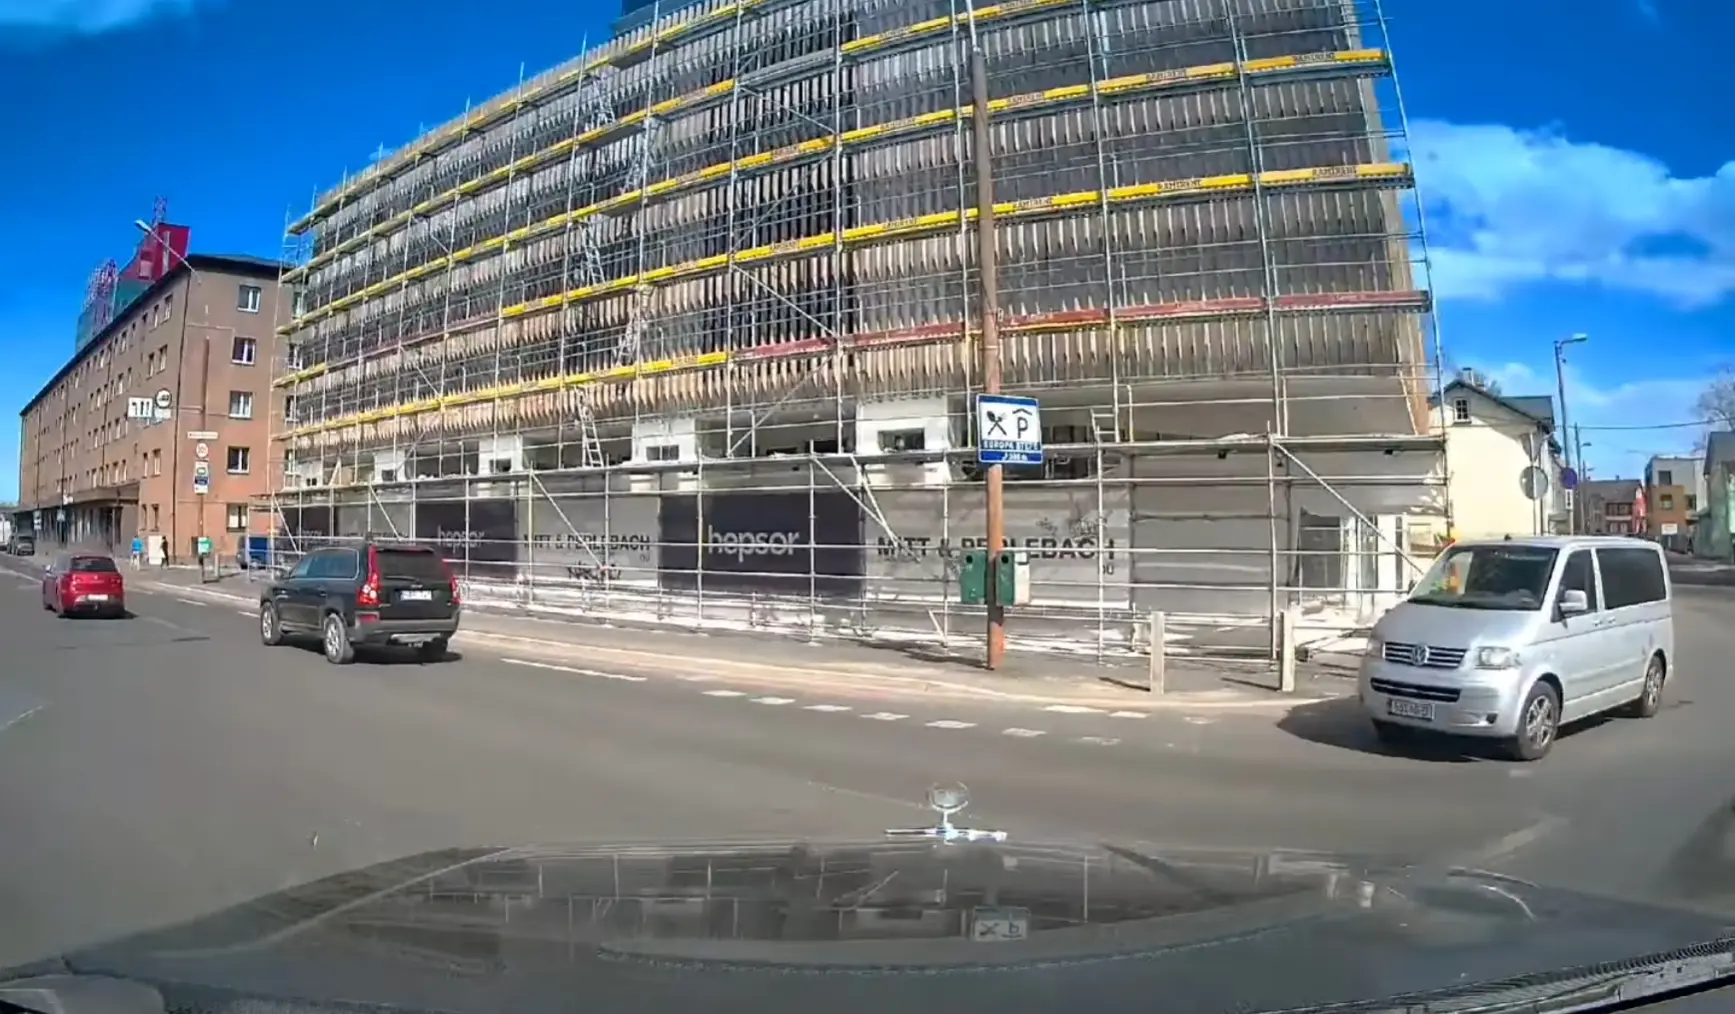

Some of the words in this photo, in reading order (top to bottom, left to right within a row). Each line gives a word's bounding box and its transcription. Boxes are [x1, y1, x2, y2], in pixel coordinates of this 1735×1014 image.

[1017, 417, 1029, 439] P
[437, 525, 485, 554] hepsor
[707, 524, 800, 563] hepsor
[961, 537, 1115, 560] PEBACH
